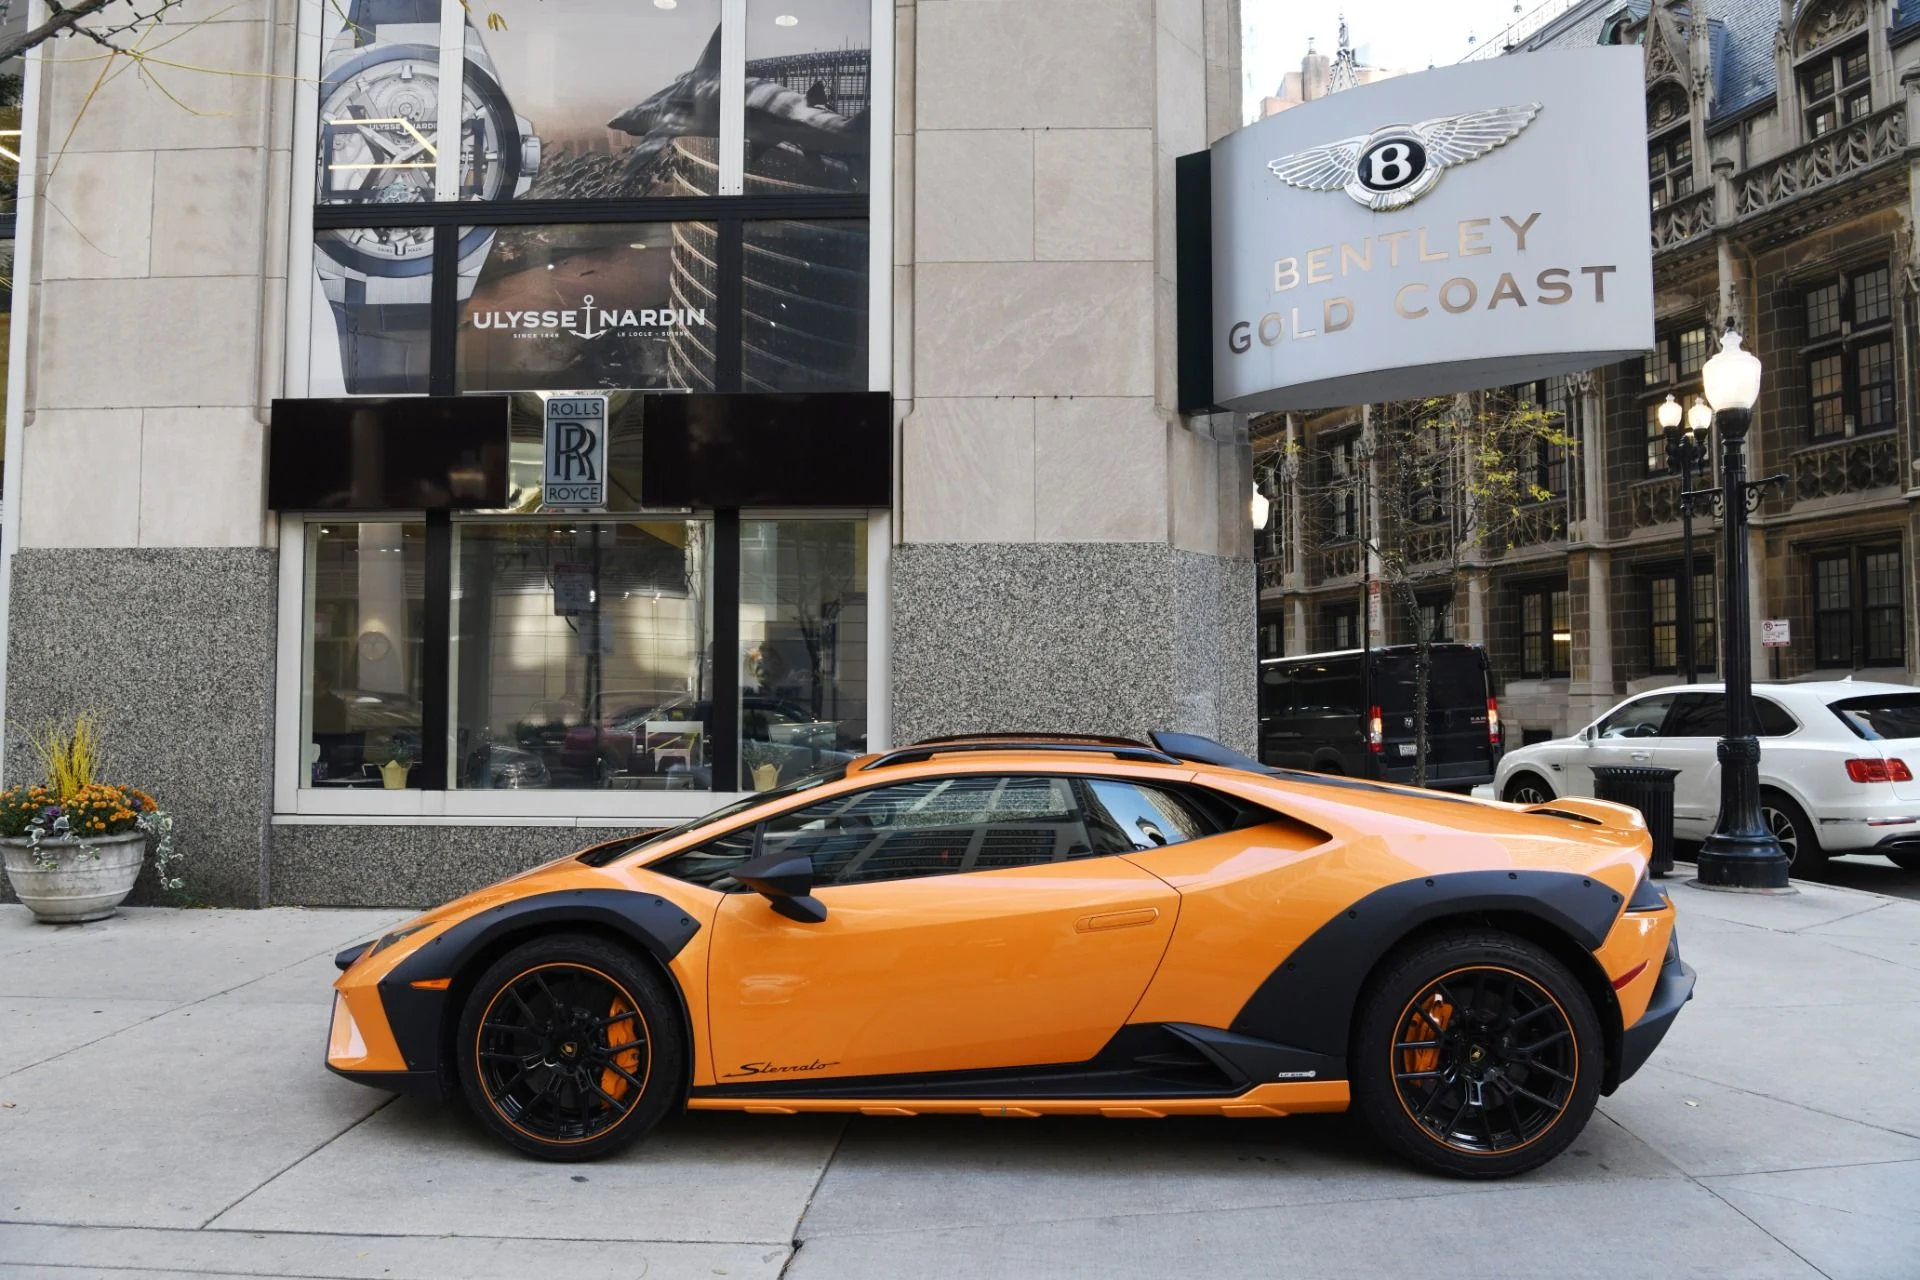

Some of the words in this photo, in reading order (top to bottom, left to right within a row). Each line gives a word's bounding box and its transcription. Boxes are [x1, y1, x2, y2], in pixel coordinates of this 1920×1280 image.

[1368, 143, 1412, 186] B
[1273, 212, 1541, 293] BENTLEY
[473, 310, 577, 329] ULYSSE
[600, 309, 706, 327] NARDIN
[1228, 296, 1355, 354] GOLD
[1394, 265, 1617, 320] COAST
[551, 402, 600, 415] ROLLS
[553, 421, 597, 481] RR
[549, 487, 598, 500] ROYCE
[722, 1058, 841, 1077] Sterrato
